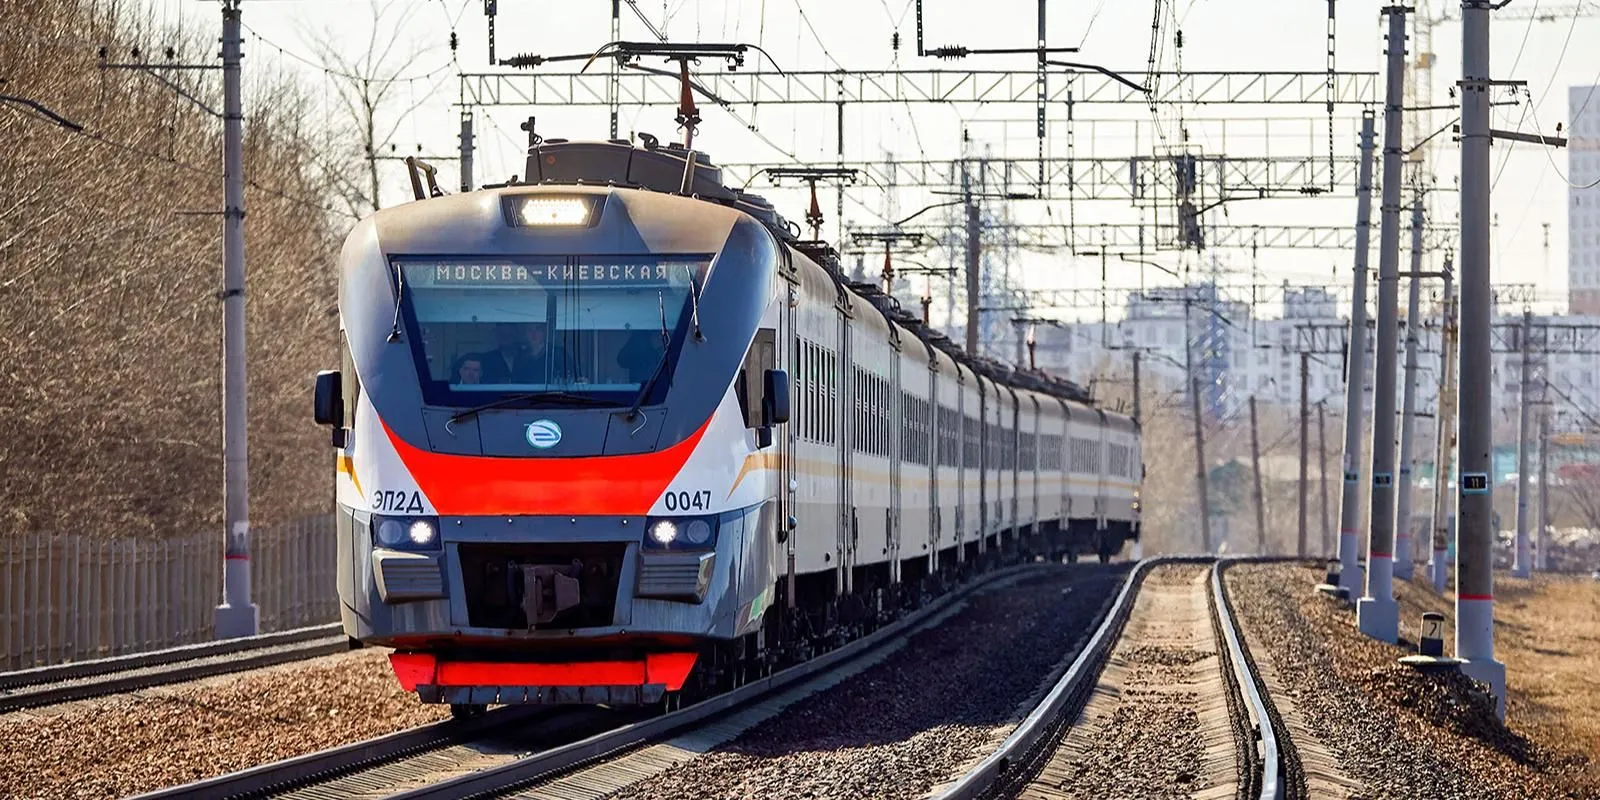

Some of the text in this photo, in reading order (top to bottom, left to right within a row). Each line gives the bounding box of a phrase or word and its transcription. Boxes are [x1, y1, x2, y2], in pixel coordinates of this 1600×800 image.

[436, 264, 668, 280] МОСКВА-КИЕВСКАЯ
[1471, 477, 1479, 488] 11
[372, 490, 424, 512] ЭП2Д
[664, 491, 712, 511] 0047
[1429, 622, 1437, 636] 7
